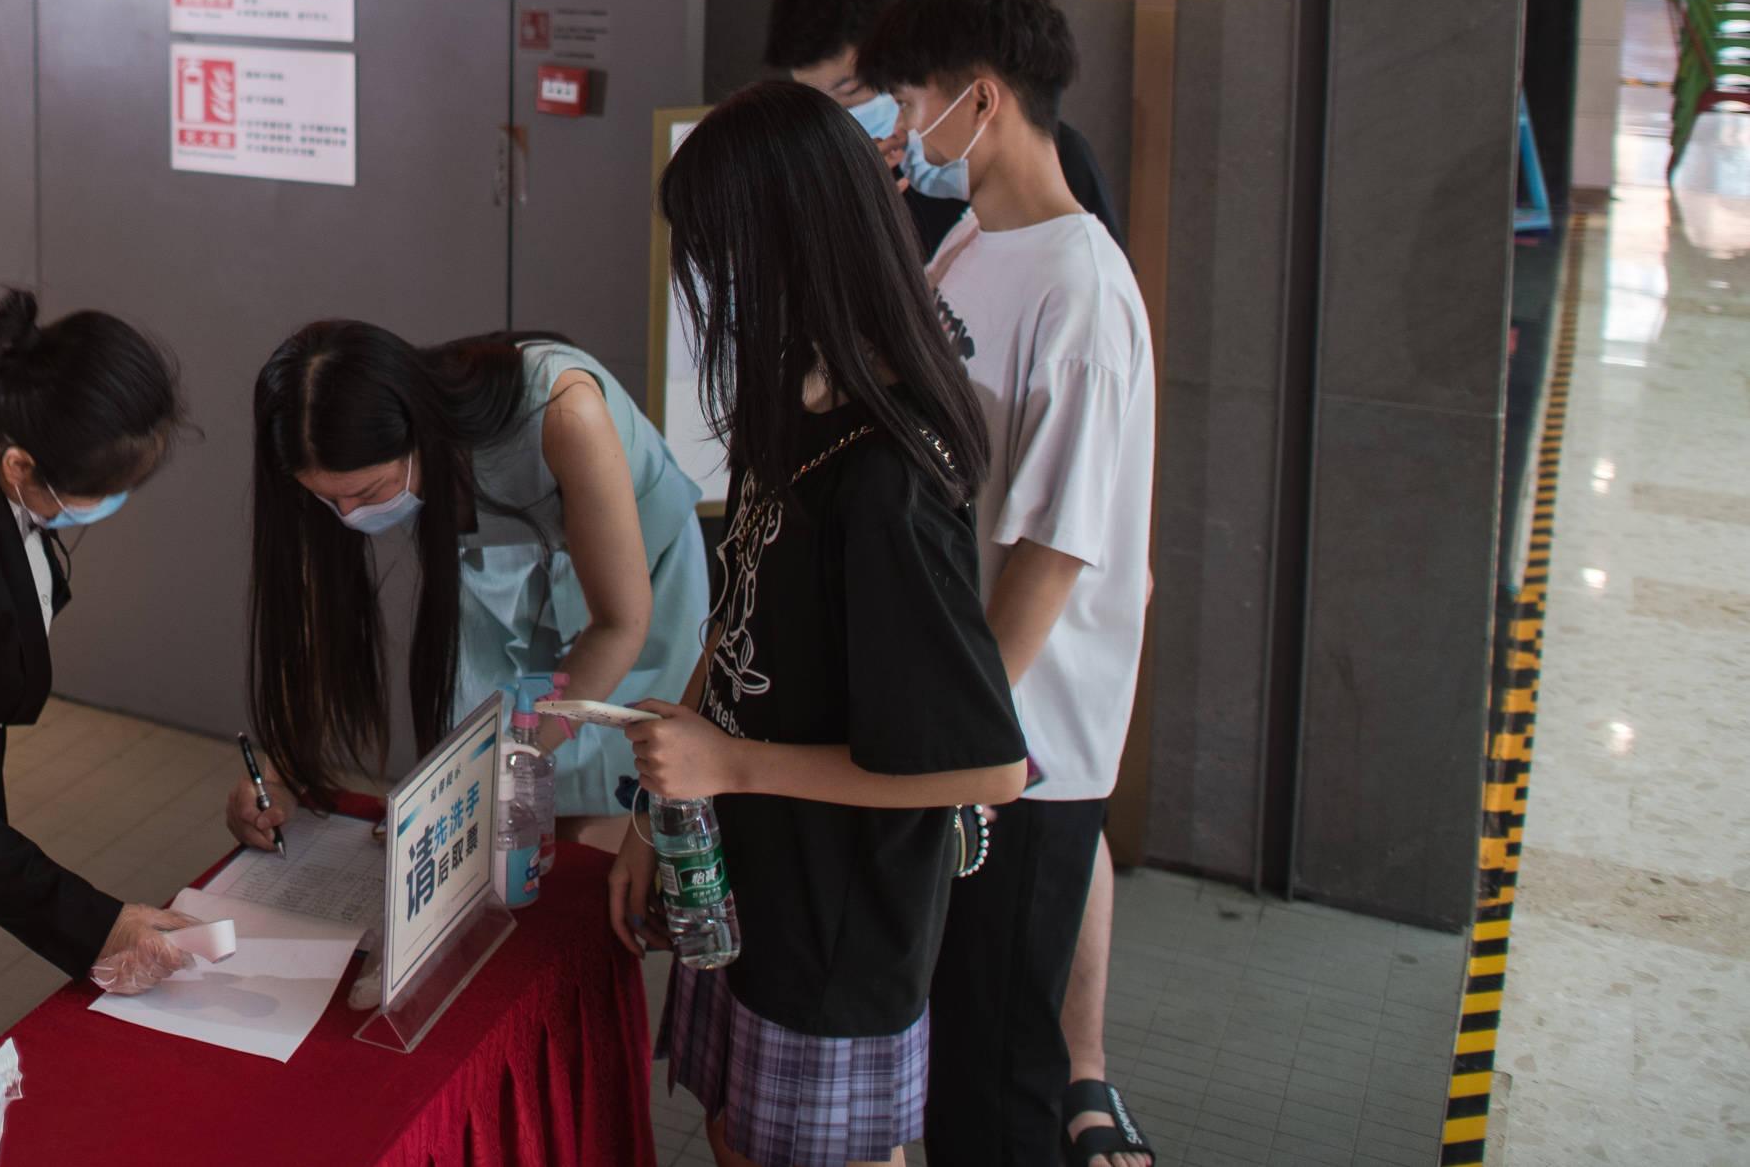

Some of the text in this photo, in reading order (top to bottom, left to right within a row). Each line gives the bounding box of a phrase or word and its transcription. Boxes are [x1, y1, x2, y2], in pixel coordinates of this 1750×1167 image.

[433, 780, 480, 854] 先洗手
[406, 824, 435, 922] 请
[437, 822, 479, 888] 后取票
